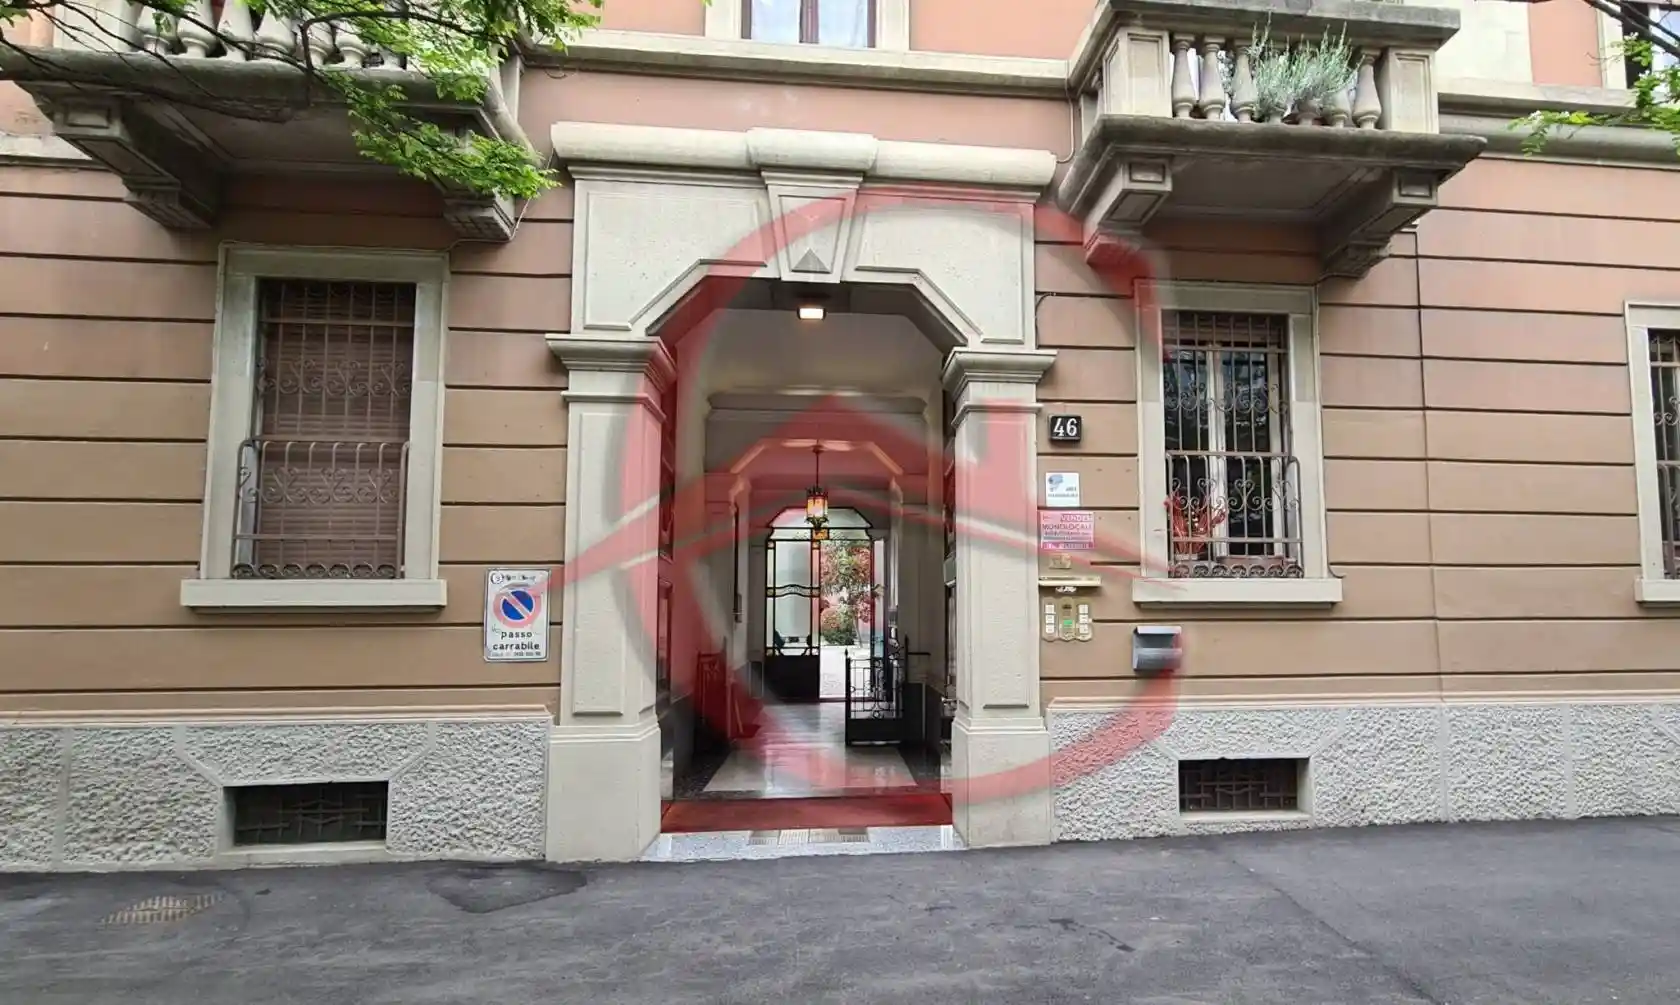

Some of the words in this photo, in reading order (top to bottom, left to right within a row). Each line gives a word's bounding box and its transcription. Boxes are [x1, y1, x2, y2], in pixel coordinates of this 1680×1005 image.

[1053, 417, 1078, 437] 46
[501, 631, 533, 640] passo
[492, 641, 540, 651] carrabile
